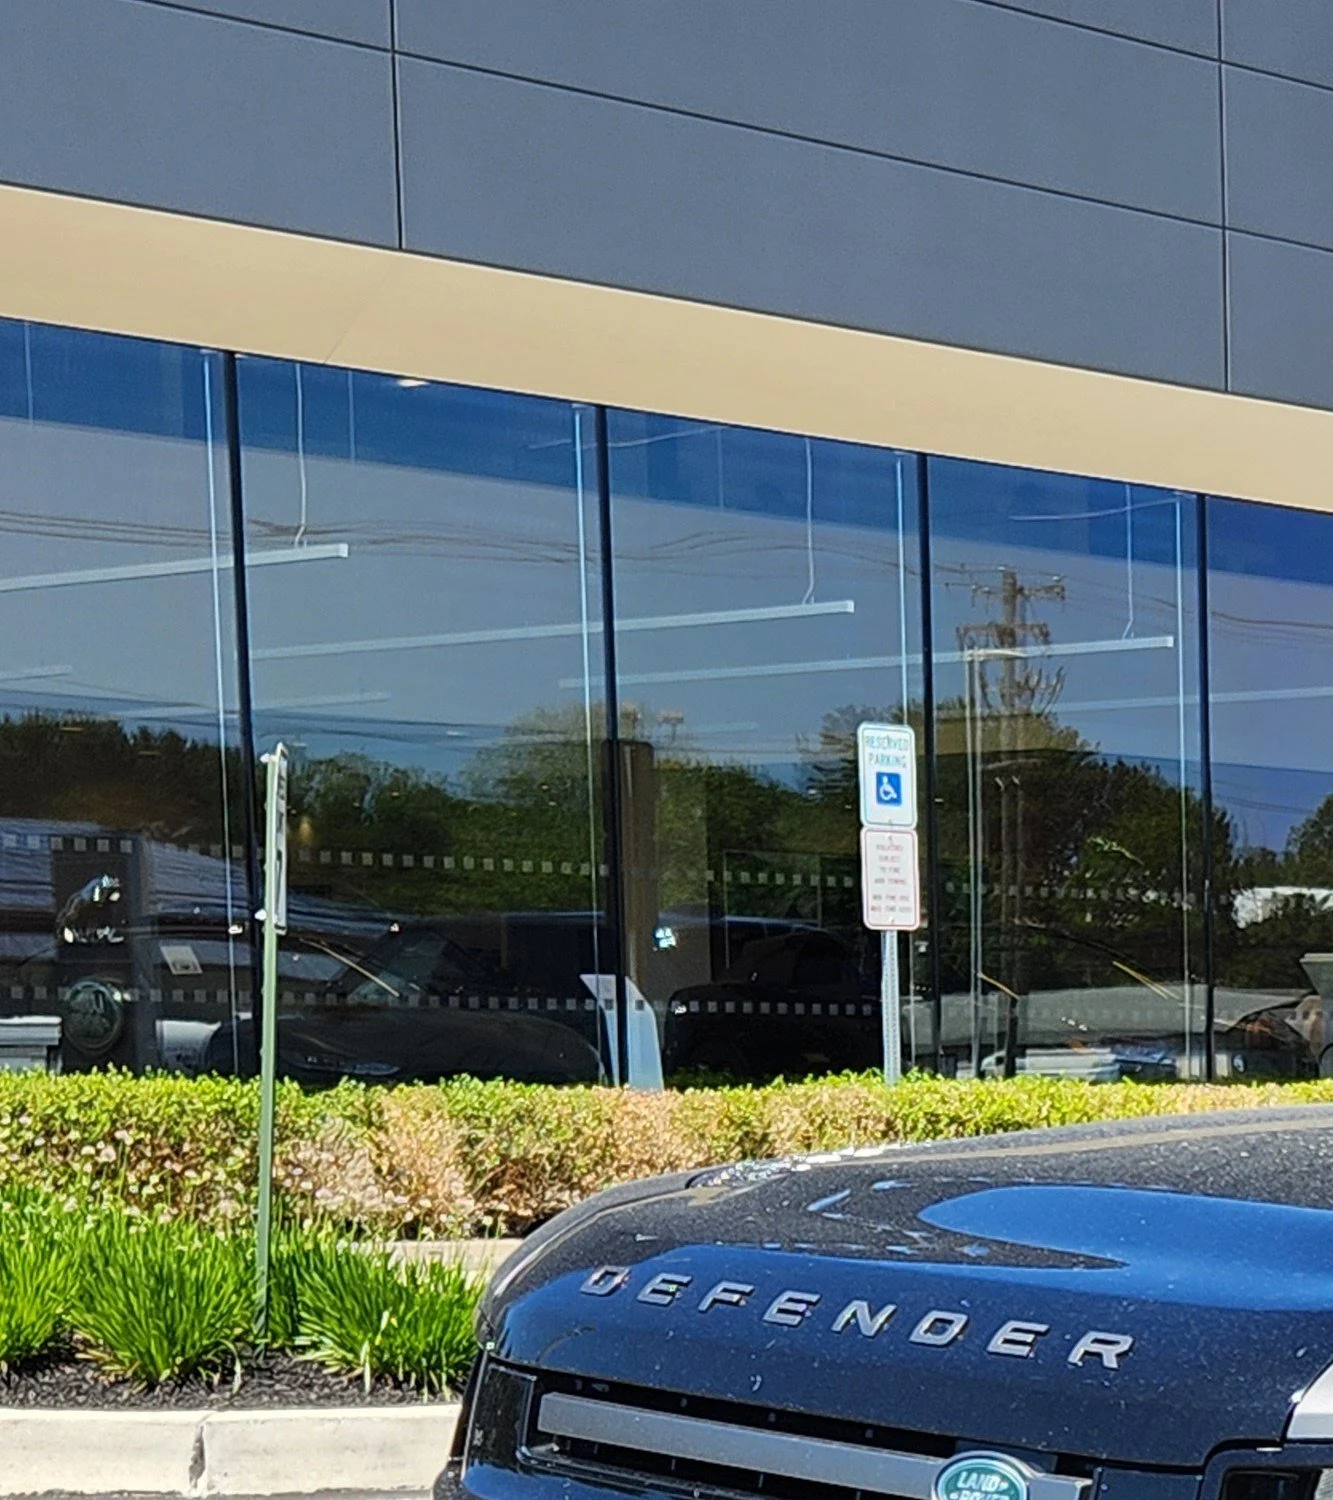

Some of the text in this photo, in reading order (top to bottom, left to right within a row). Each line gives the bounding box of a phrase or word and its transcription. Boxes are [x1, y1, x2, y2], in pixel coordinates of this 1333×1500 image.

[868, 752, 907, 769] PARKING
[579, 1265, 1135, 1369] DEFENDER
[957, 1471, 1001, 1492] LAND
